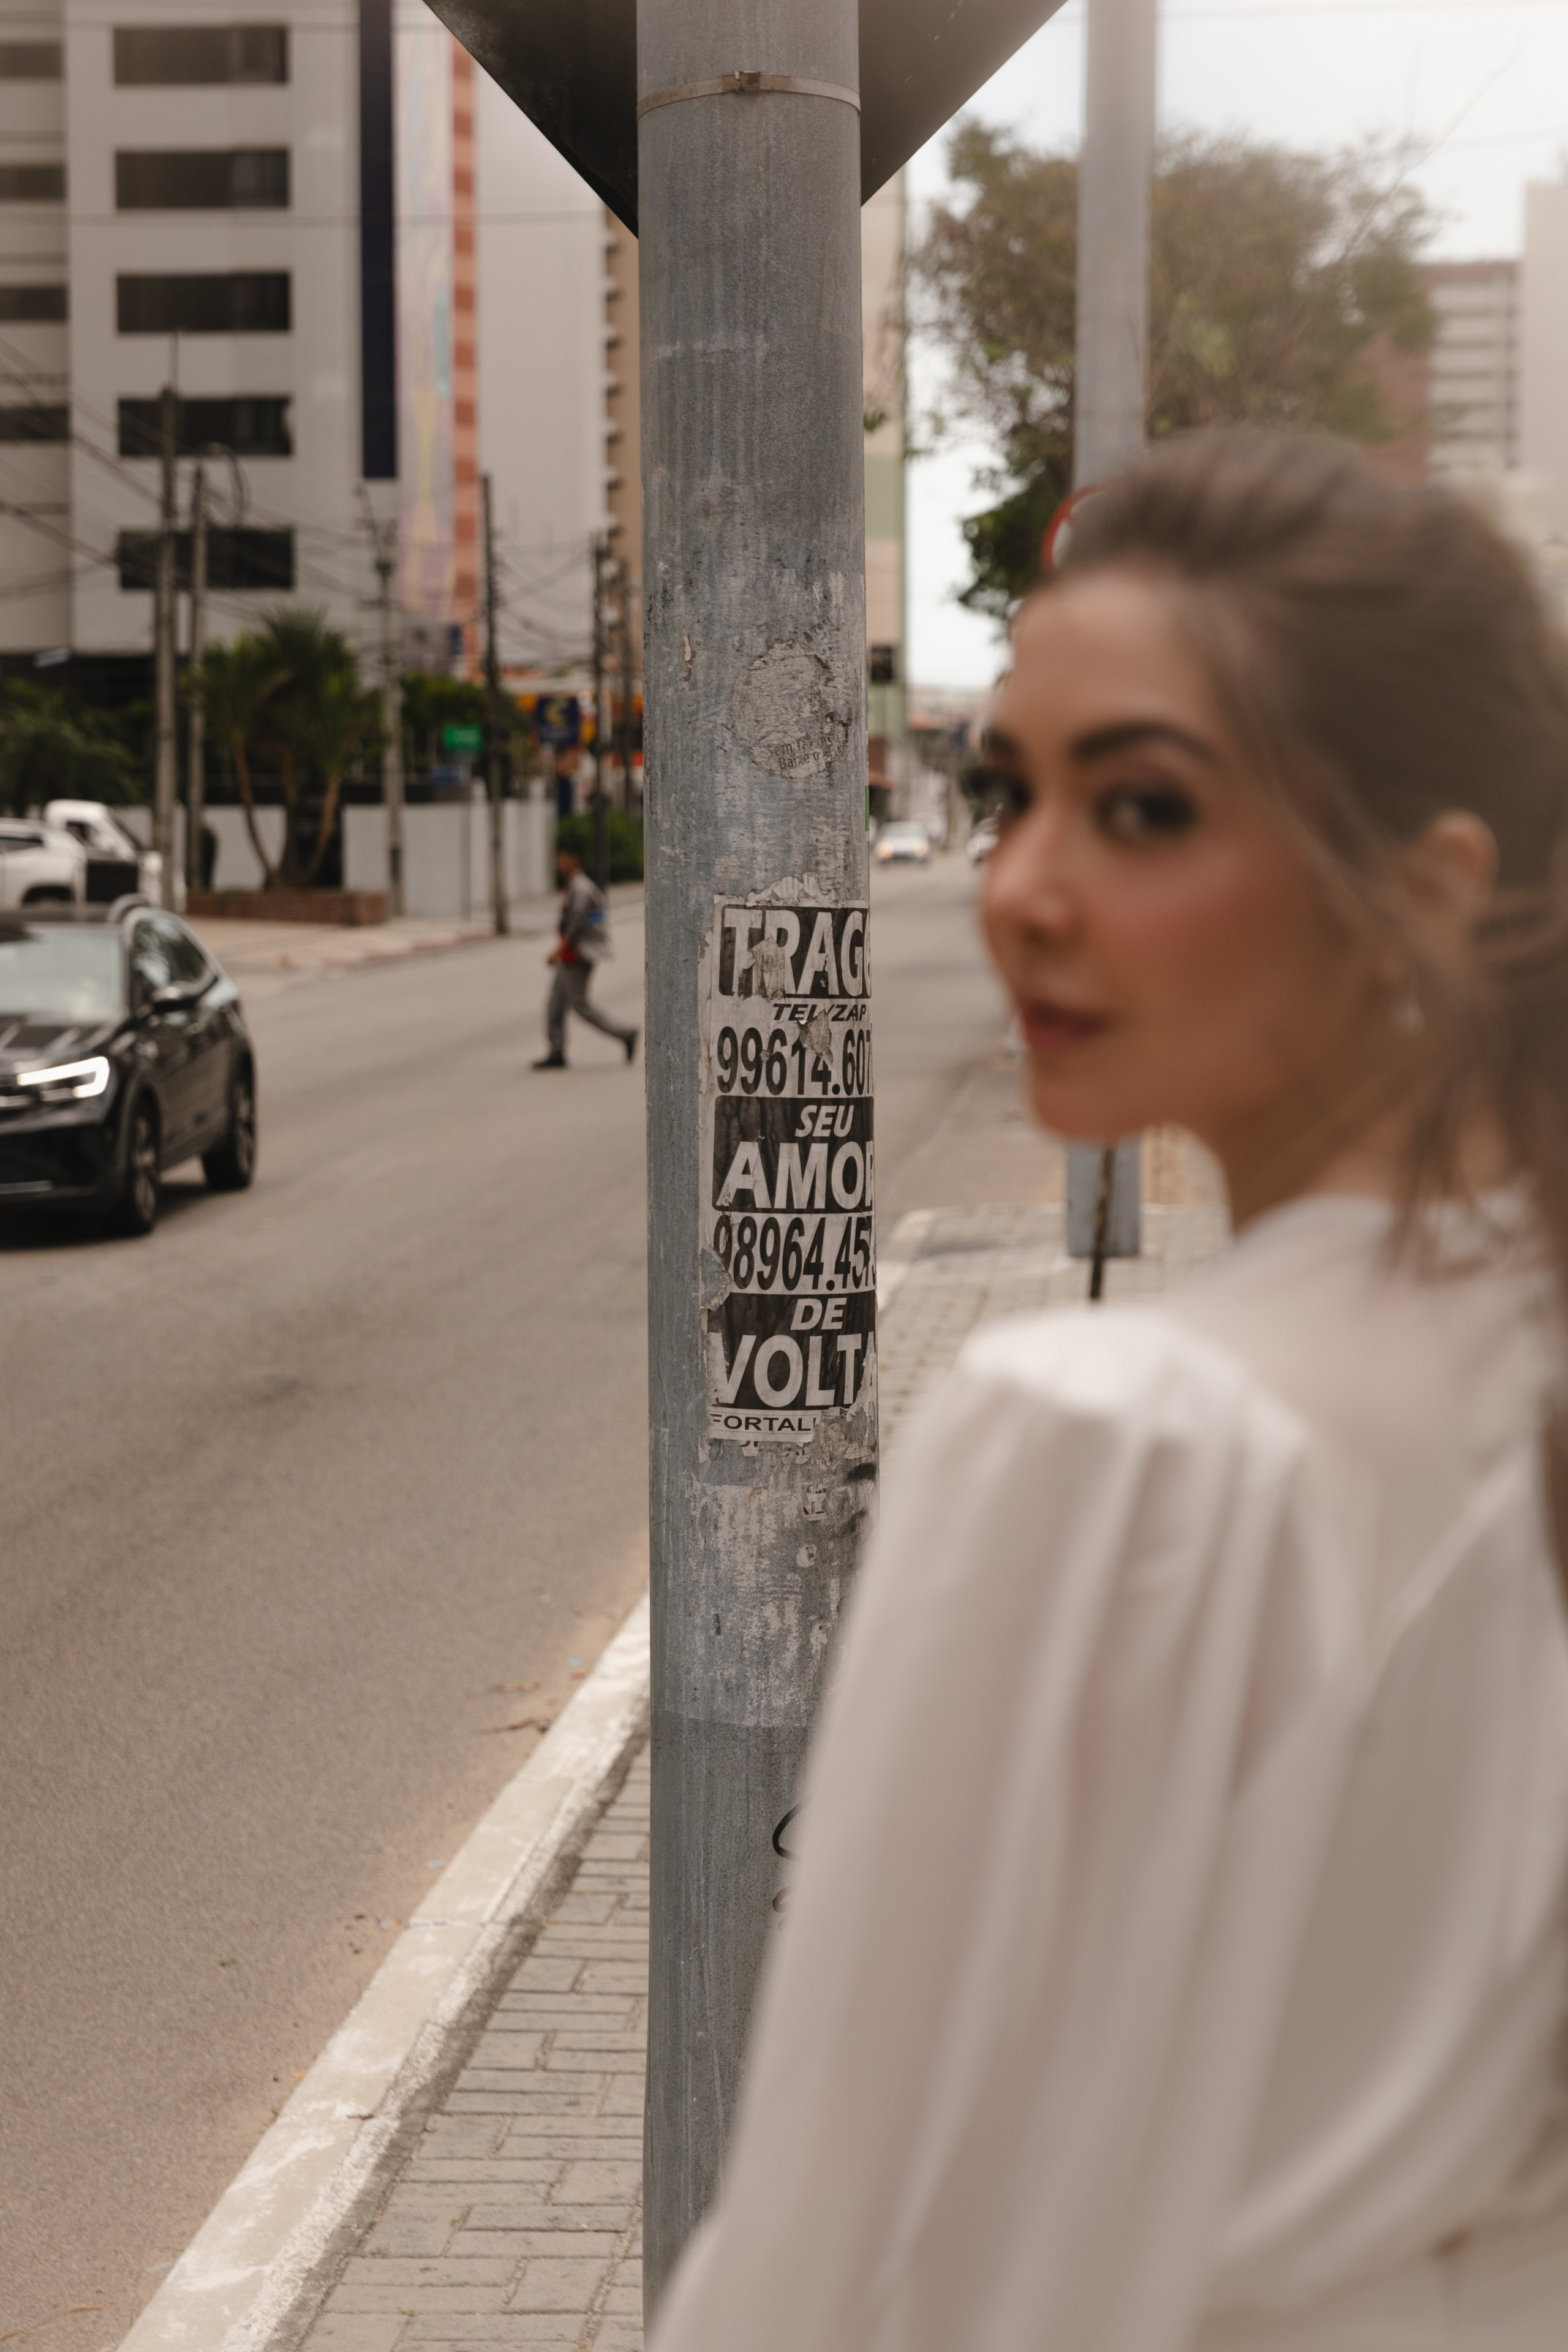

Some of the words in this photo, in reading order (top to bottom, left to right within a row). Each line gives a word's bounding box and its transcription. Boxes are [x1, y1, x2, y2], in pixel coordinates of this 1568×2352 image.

[795, 1104, 854, 1138] SEU
[790, 1297, 848, 1331] DE
[710, 1414, 816, 1432] FORTAL
